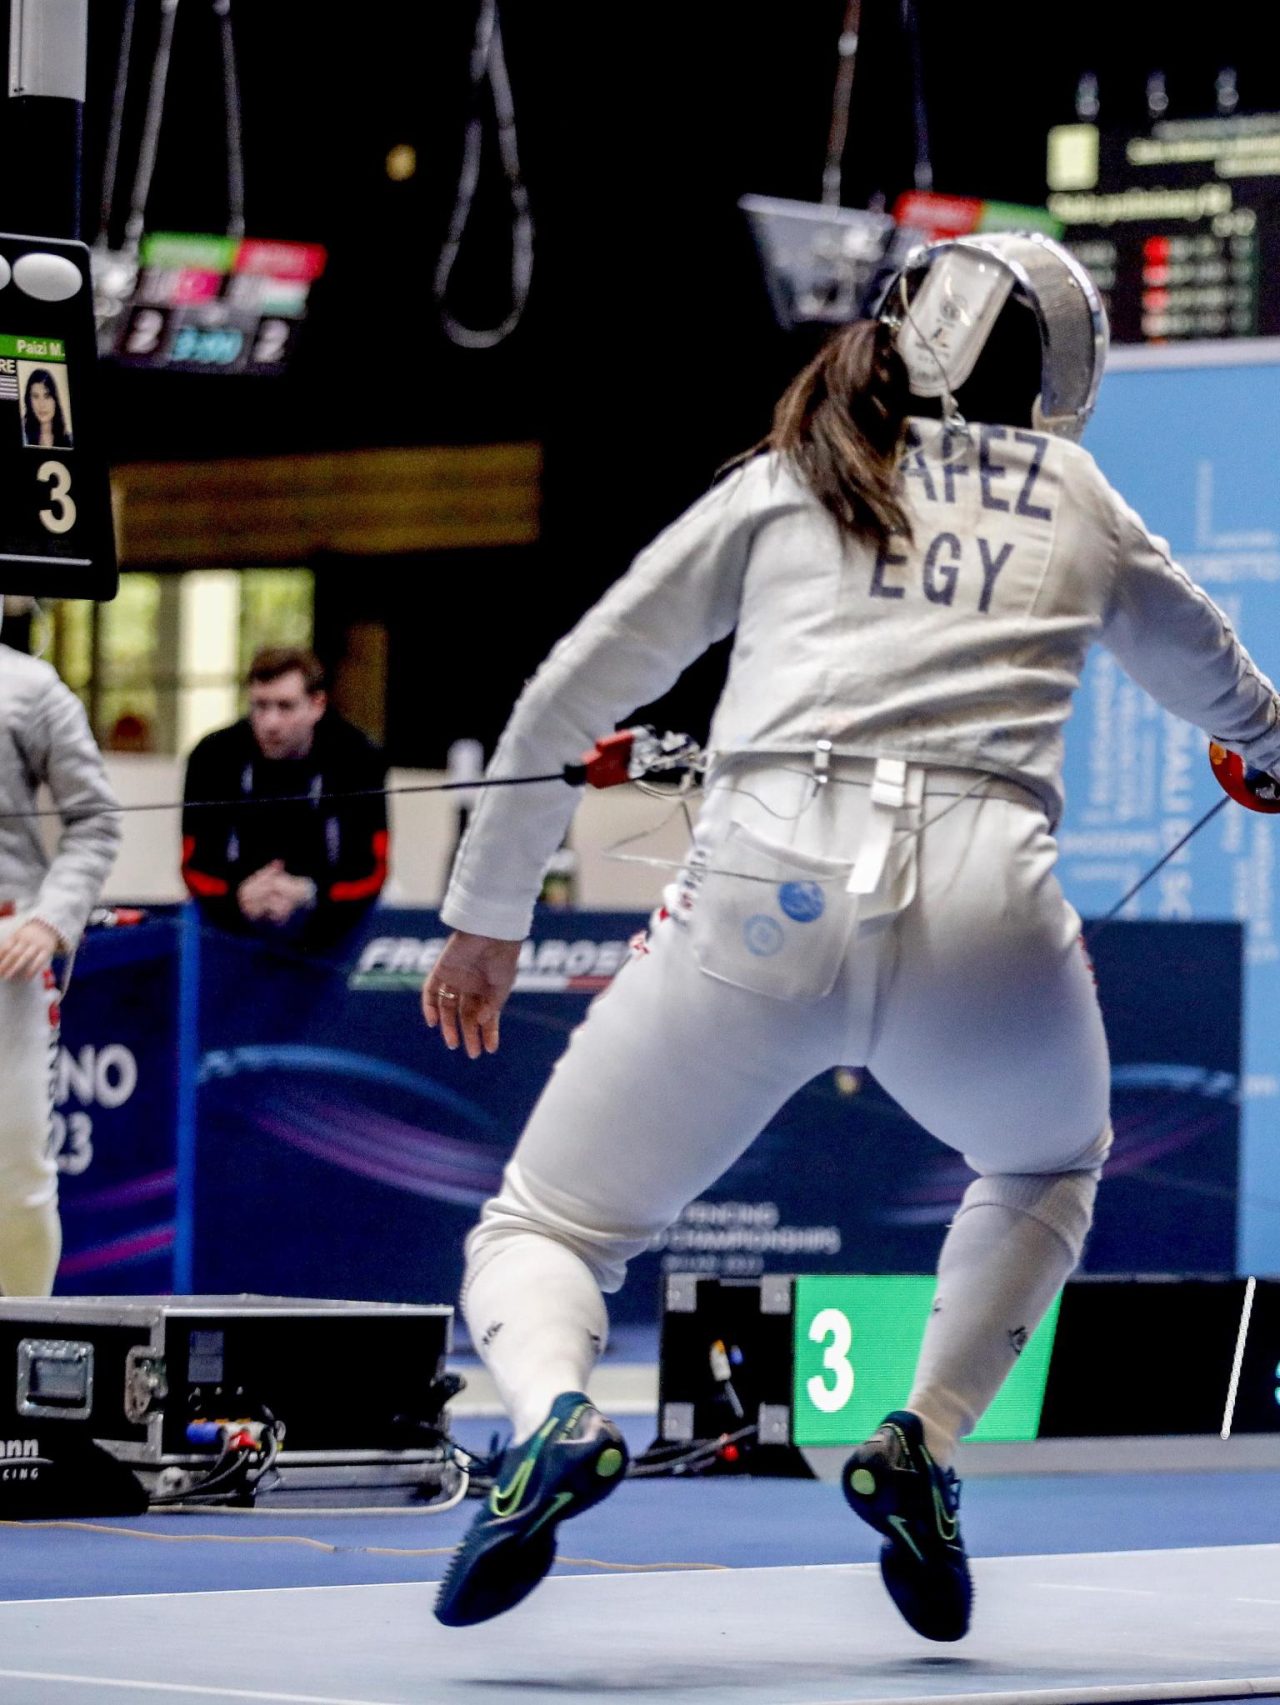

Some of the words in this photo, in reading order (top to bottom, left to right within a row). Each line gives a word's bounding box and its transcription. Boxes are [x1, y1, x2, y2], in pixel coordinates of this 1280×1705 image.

[16, 339, 48, 355] Paizi
[50, 342, 66, 356] M.
[36, 460, 77, 534] 3
[869, 531, 1015, 614] EGY
[807, 1308, 855, 1413] 3
[2, 1467, 39, 1481] CING
